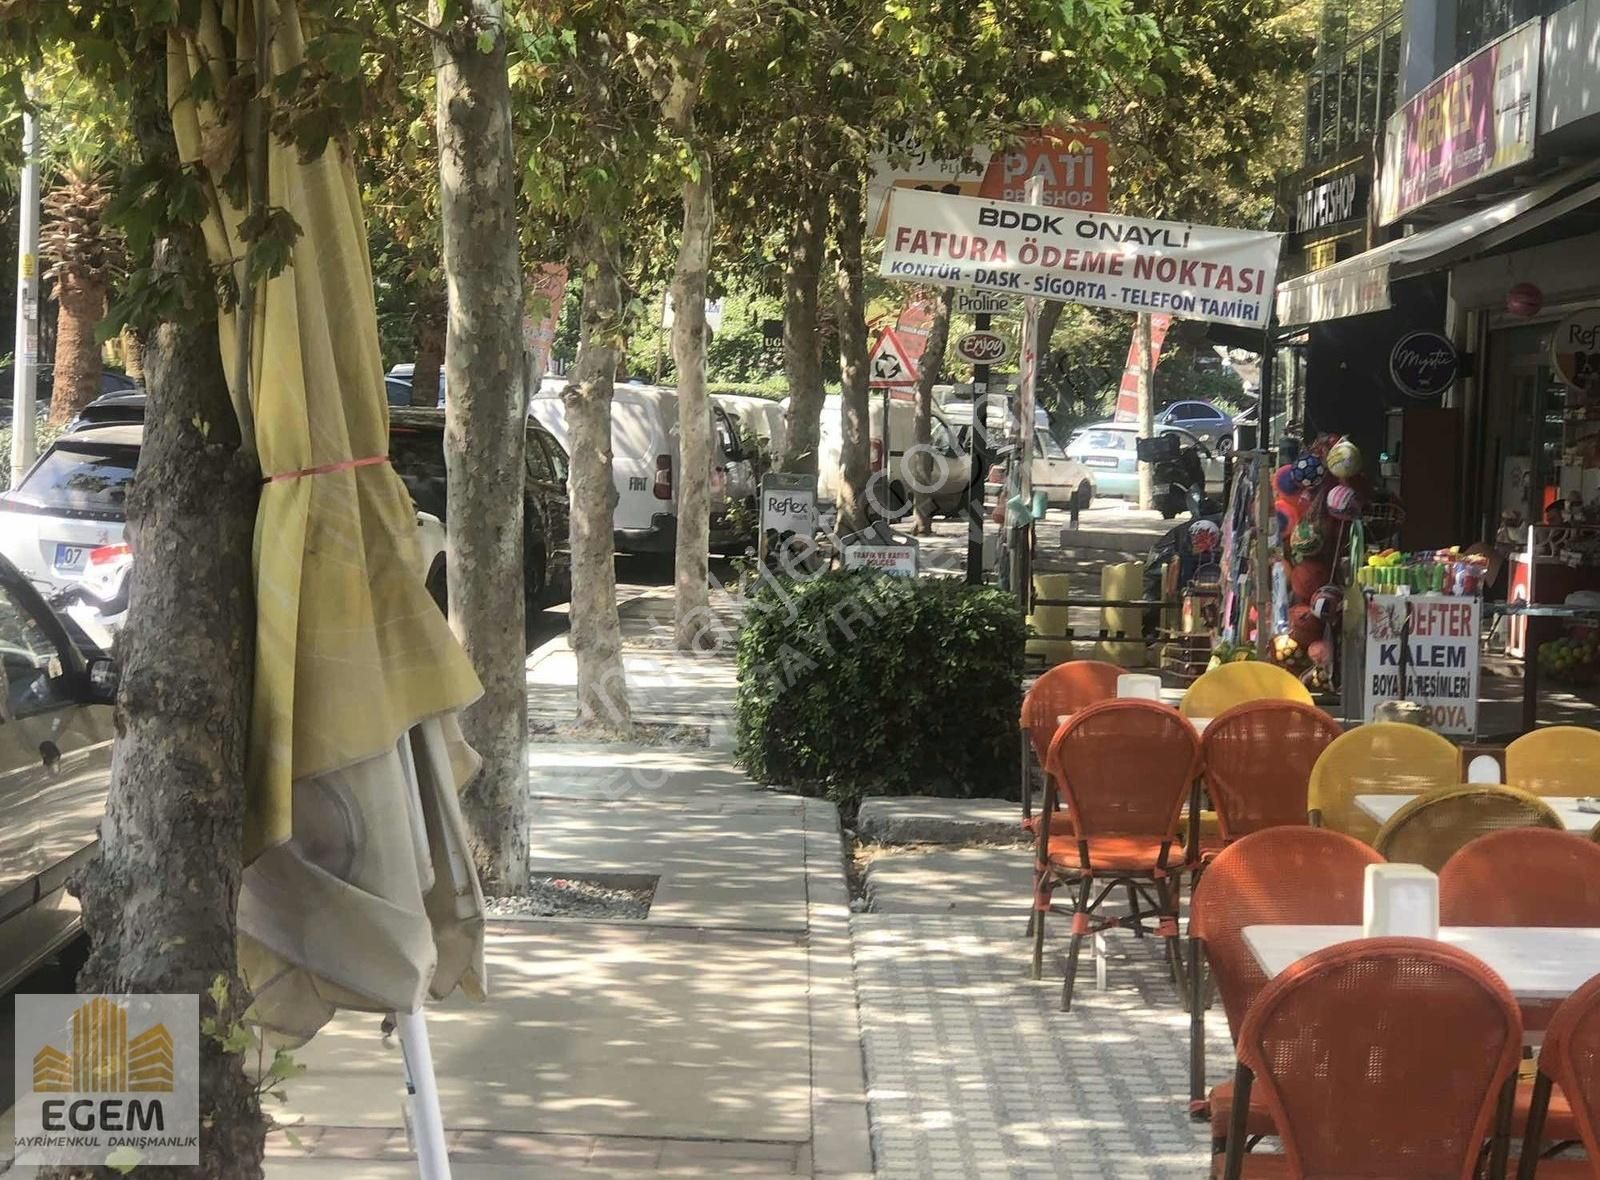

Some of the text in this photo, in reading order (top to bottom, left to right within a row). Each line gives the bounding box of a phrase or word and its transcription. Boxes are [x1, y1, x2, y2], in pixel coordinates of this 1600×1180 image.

[1004, 146, 1093, 187] PATİ
[978, 207, 1064, 236] BDDK
[894, 226, 1008, 263] FATURA
[1018, 237, 1123, 276] ÖDEME
[1133, 254, 1265, 295] NOKTASI
[891, 261, 961, 281] KONTÜR
[974, 268, 1021, 289] DASK
[1033, 273, 1107, 300] SİGORTA
[1121, 287, 1195, 312] TELEFON
[1200, 297, 1260, 322] TAMİRİ
[959, 295, 1009, 311] Proline
[962, 335, 1003, 357] Enjoy
[768, 496, 808, 516] Reflex
[64, 547, 82, 564] 07
[1408, 603, 1472, 637] DEFTER
[1372, 671, 1471, 699] BOYAA RESİMLERİ
